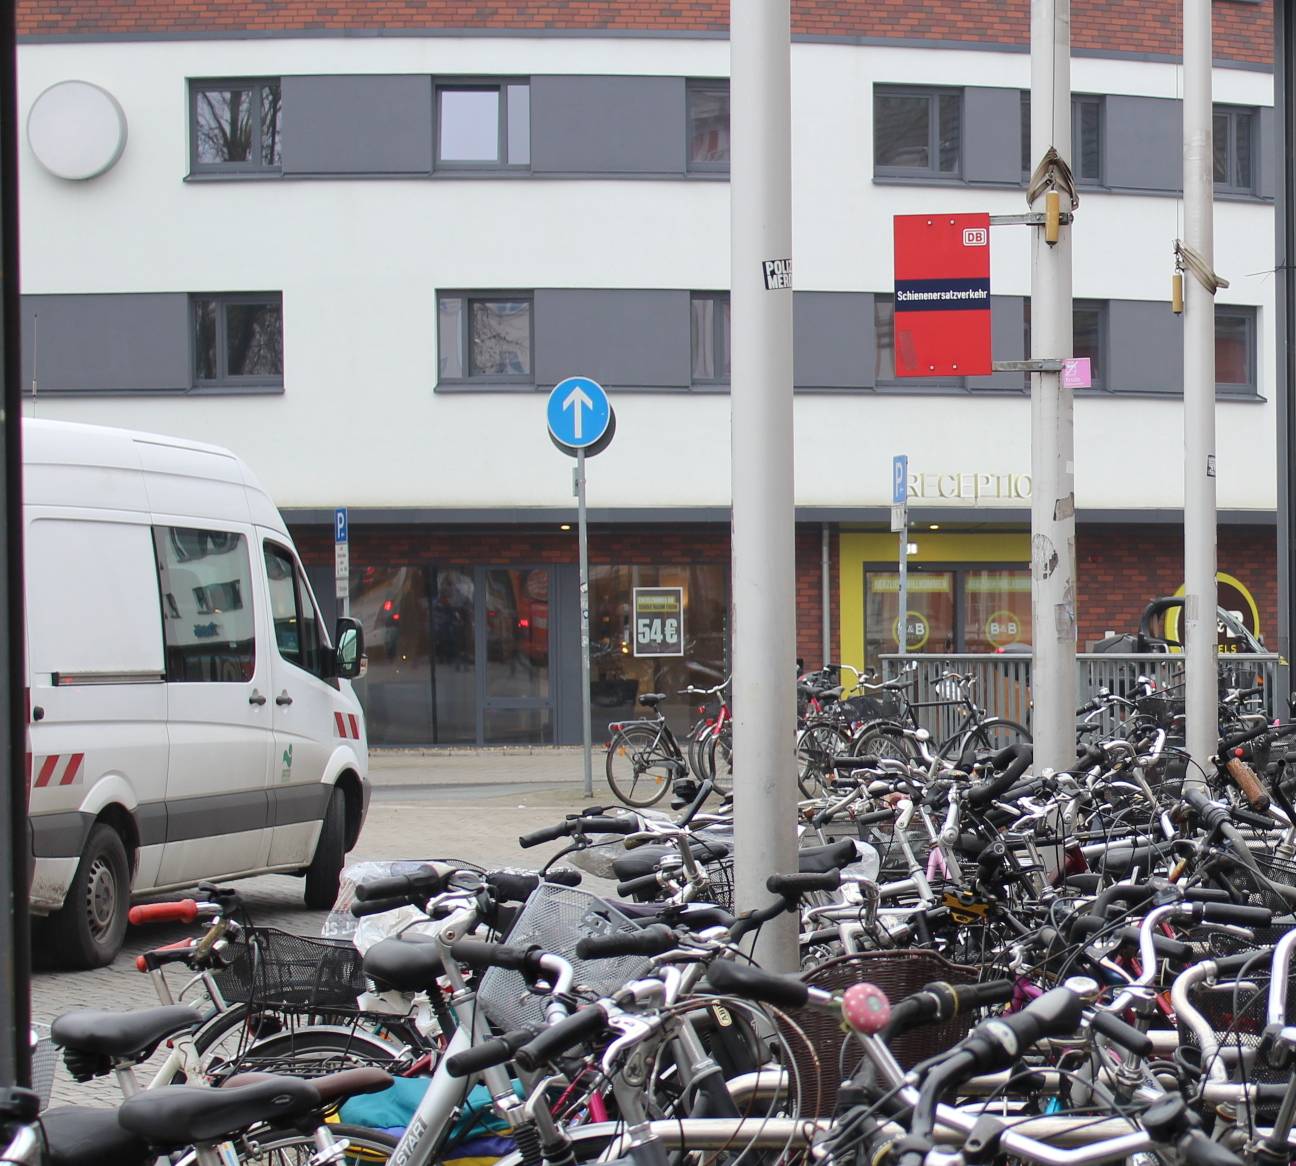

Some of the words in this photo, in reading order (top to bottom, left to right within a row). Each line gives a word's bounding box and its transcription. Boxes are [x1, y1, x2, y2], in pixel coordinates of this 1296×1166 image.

[967, 232, 983, 242] DB
[897, 288, 988, 301] Schienenersatzverkehr
[907, 473, 1032, 499] RECEPTIO
[637, 618, 663, 644] 54
[664, 618, 678, 644] €
